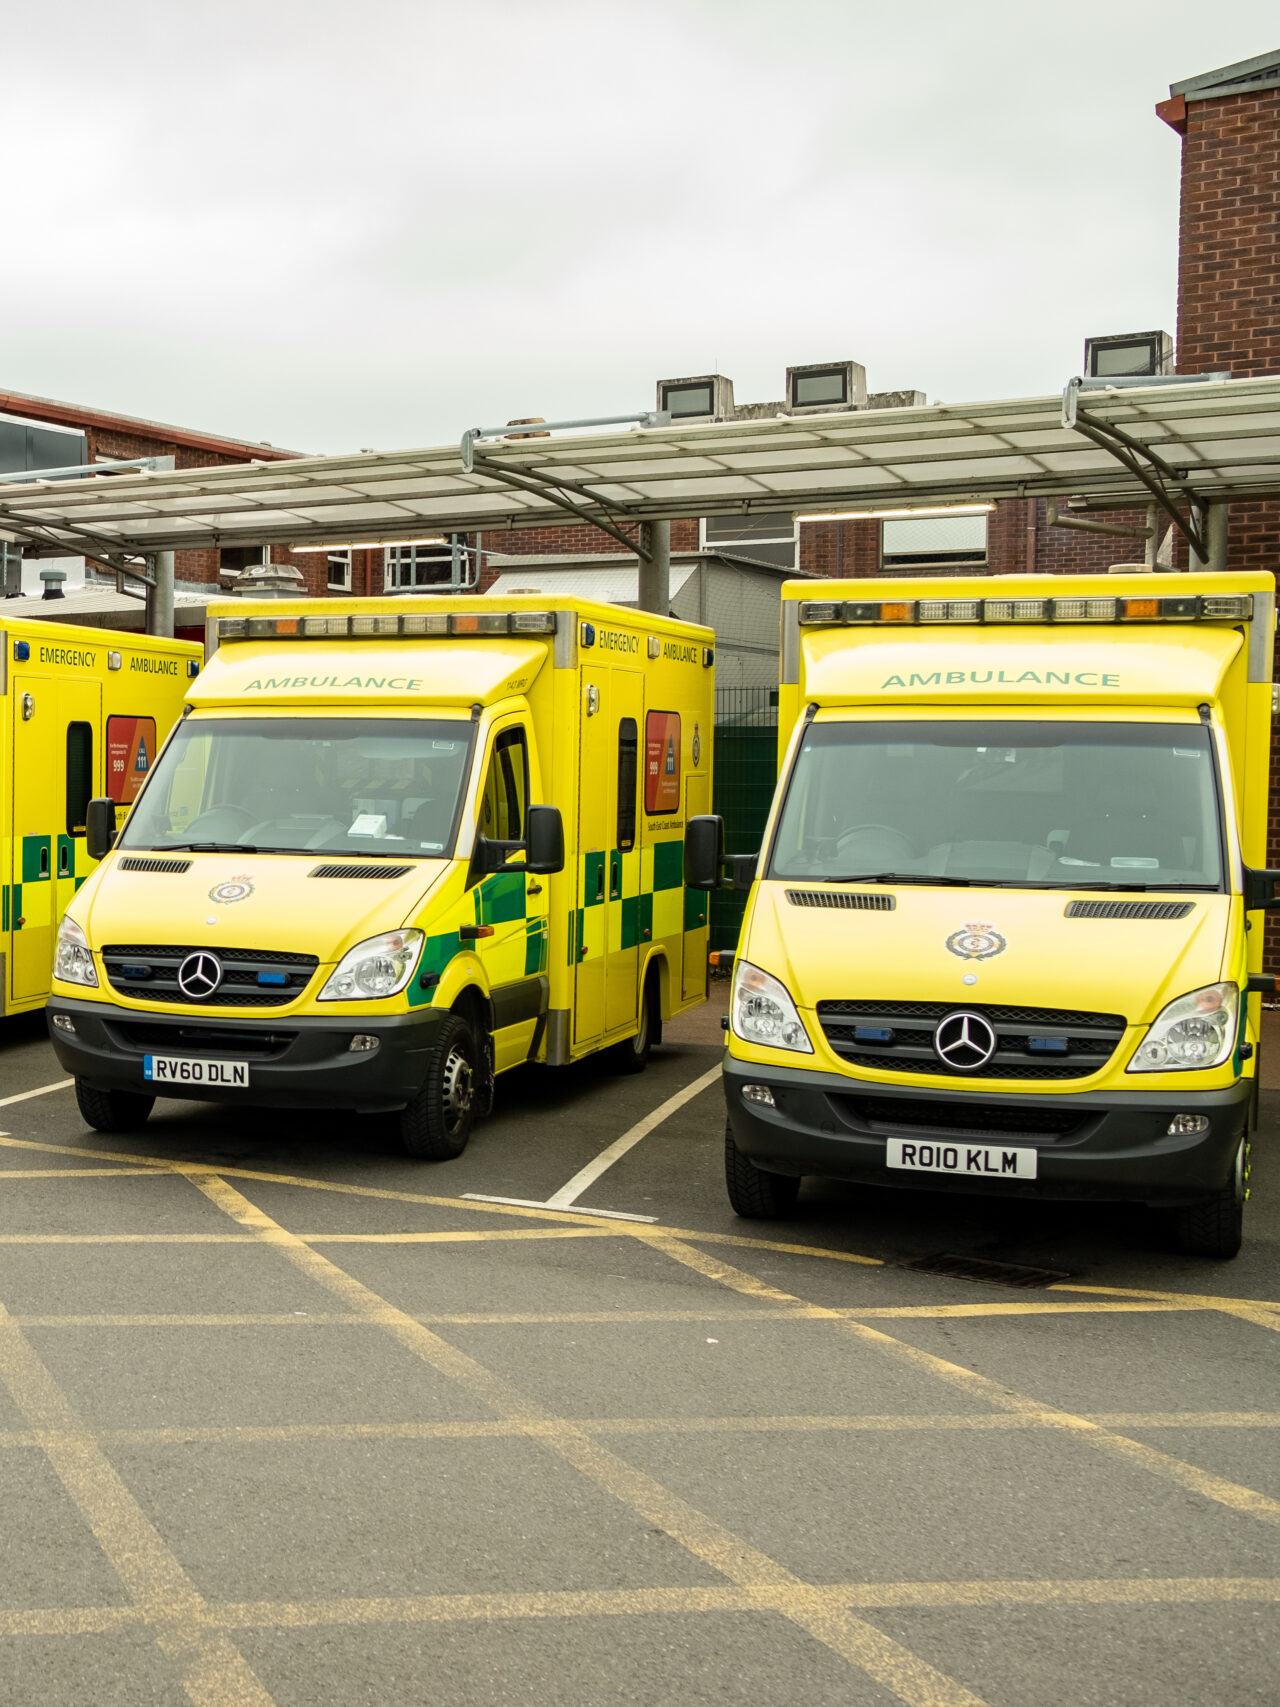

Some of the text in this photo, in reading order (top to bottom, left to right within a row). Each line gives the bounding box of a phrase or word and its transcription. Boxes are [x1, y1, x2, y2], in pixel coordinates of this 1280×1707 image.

[600, 630, 697, 664] EMERGENCY AMBULANCE
[40, 647, 178, 676] EMERGENCY AMBULANCE
[243, 676, 424, 691] AMBULANCE
[880, 670, 1121, 688] AMBULANCE
[113, 760, 125, 772] 999
[156, 1060, 245, 1084] RV60 DLN
[901, 1144, 1018, 1174] RO10 KLM
